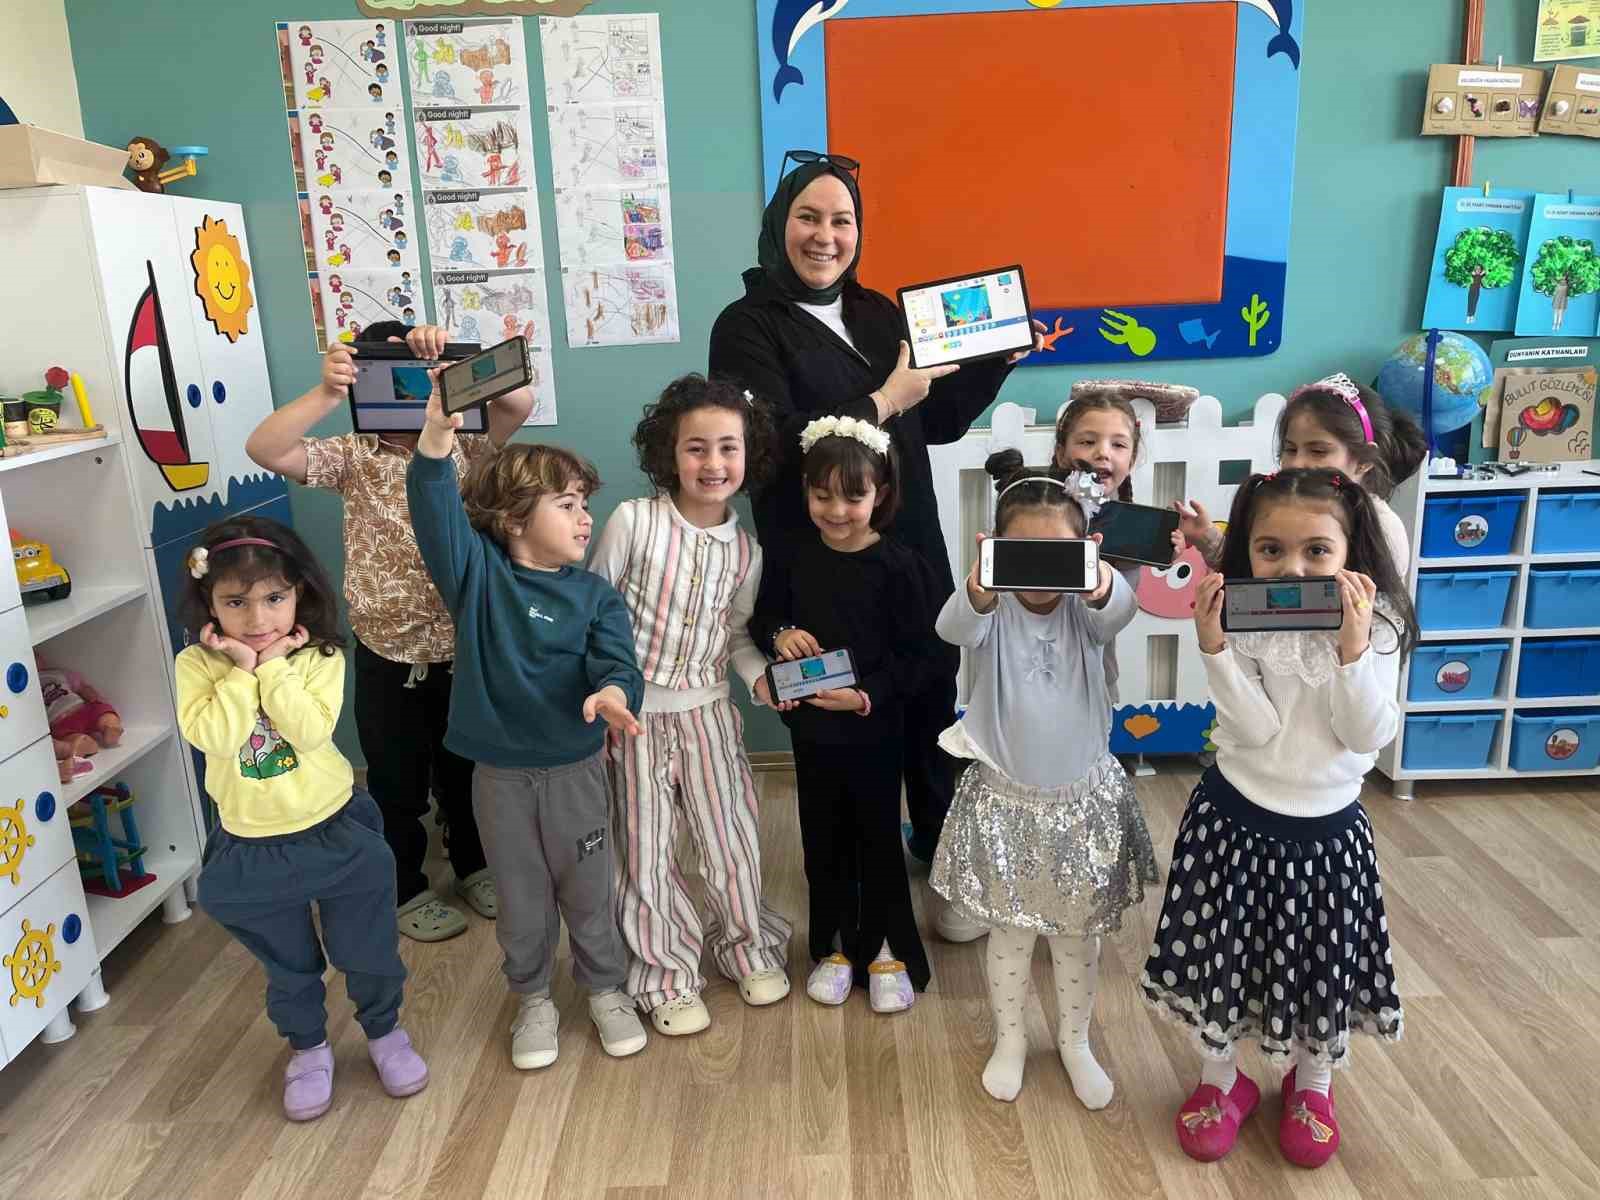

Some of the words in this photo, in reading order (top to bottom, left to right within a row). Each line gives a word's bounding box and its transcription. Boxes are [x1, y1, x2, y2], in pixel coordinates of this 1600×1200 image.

[418, 23, 439, 33] Good
[440, 22, 461, 33] night!
[427, 110, 447, 119] Good
[437, 193, 456, 201] Good
[446, 273, 465, 281] Good
[1505, 380, 1536, 406] BULUT
